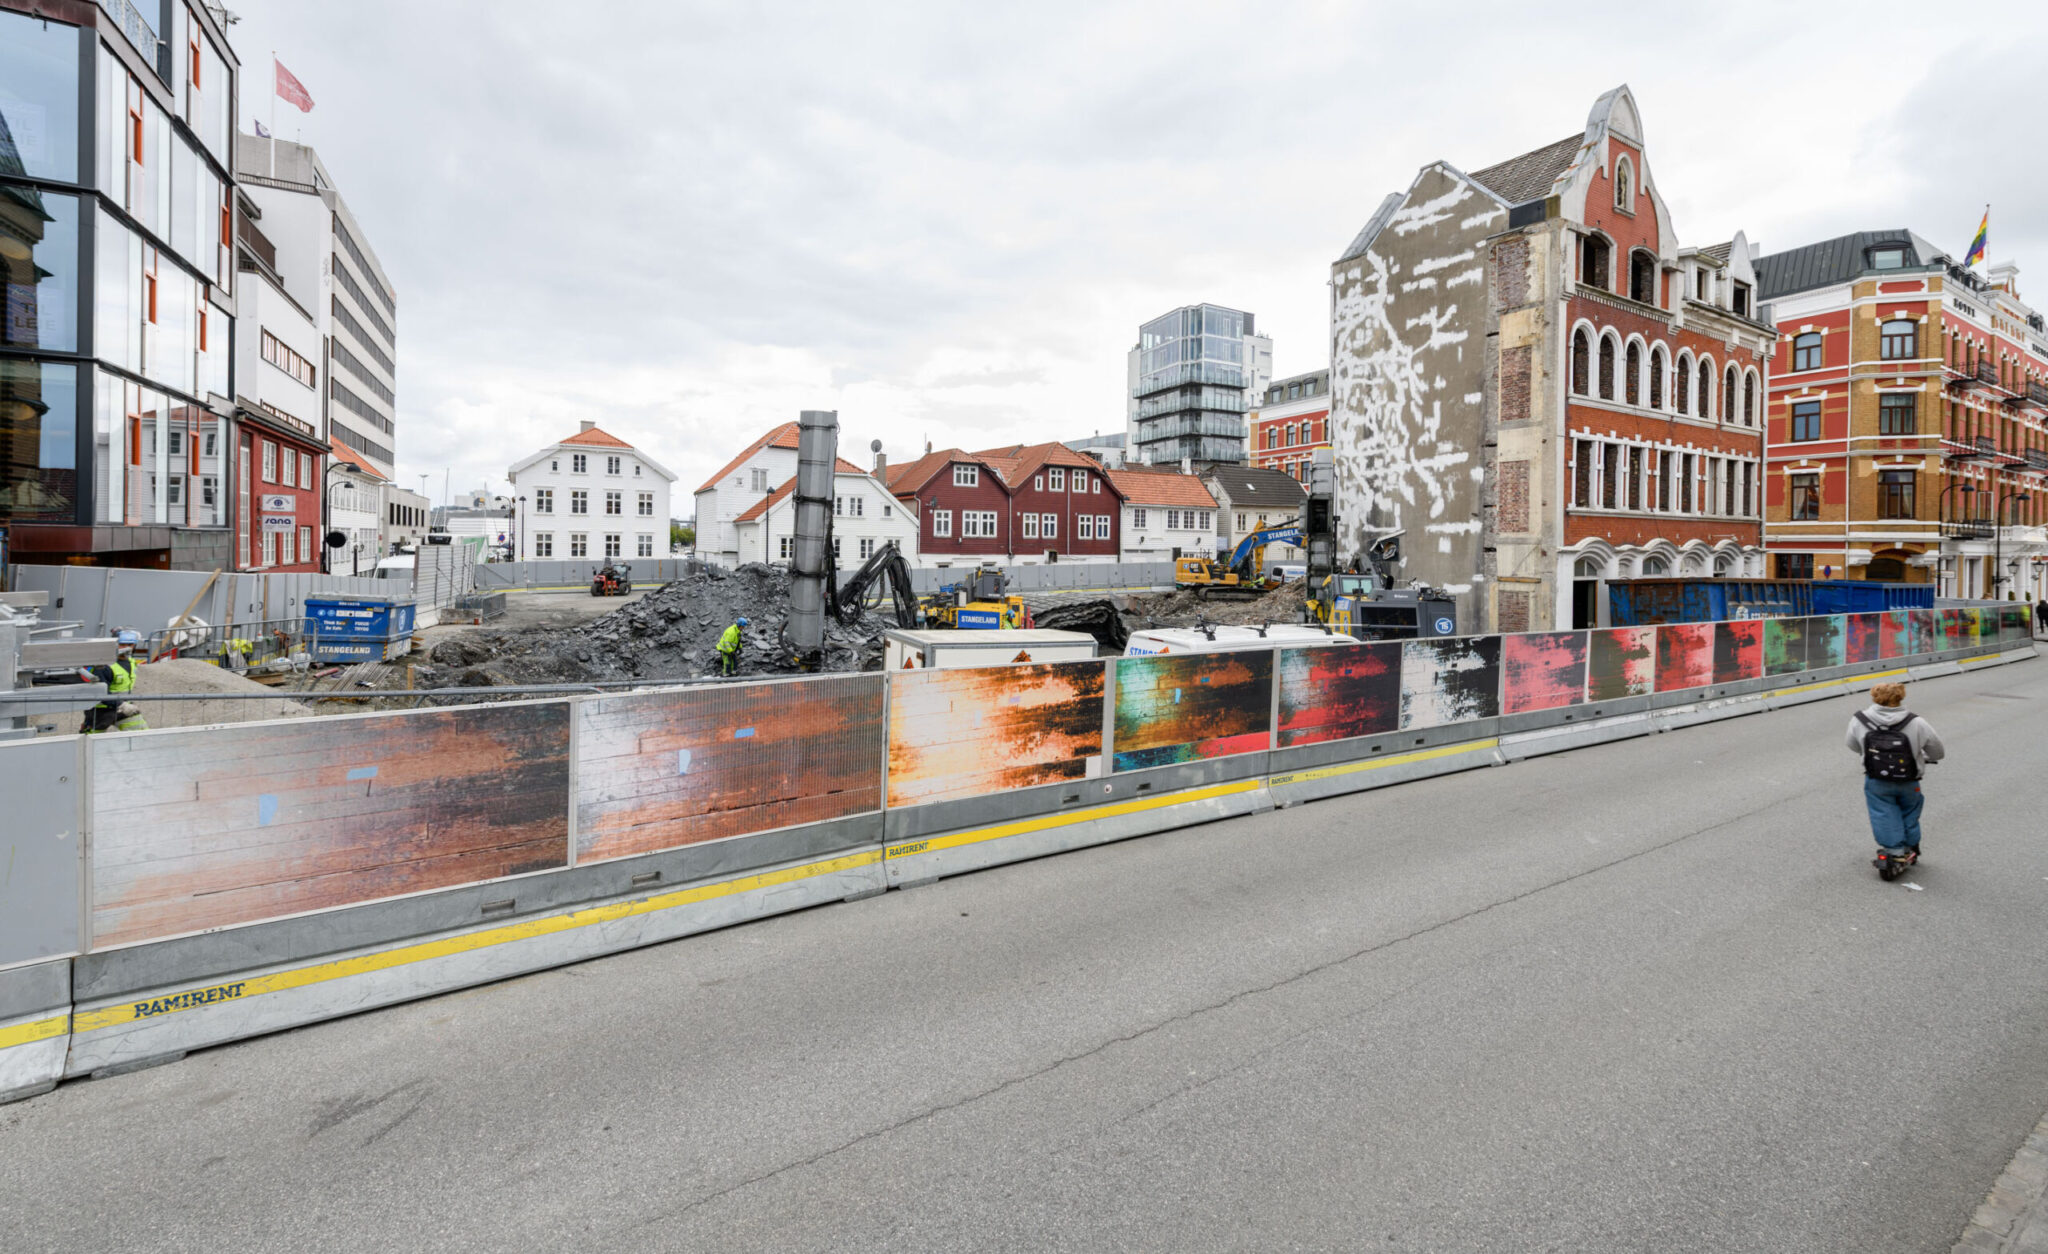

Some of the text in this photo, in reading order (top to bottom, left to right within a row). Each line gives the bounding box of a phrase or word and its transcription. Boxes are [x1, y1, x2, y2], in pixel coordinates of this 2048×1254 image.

[1267, 529, 1299, 540] STANGELA
[961, 615, 997, 624] STANGELAND
[318, 645, 371, 654] STANGELAND
[888, 841, 929, 857] RAMIRENT
[134, 982, 246, 1018] RAMIRENT
